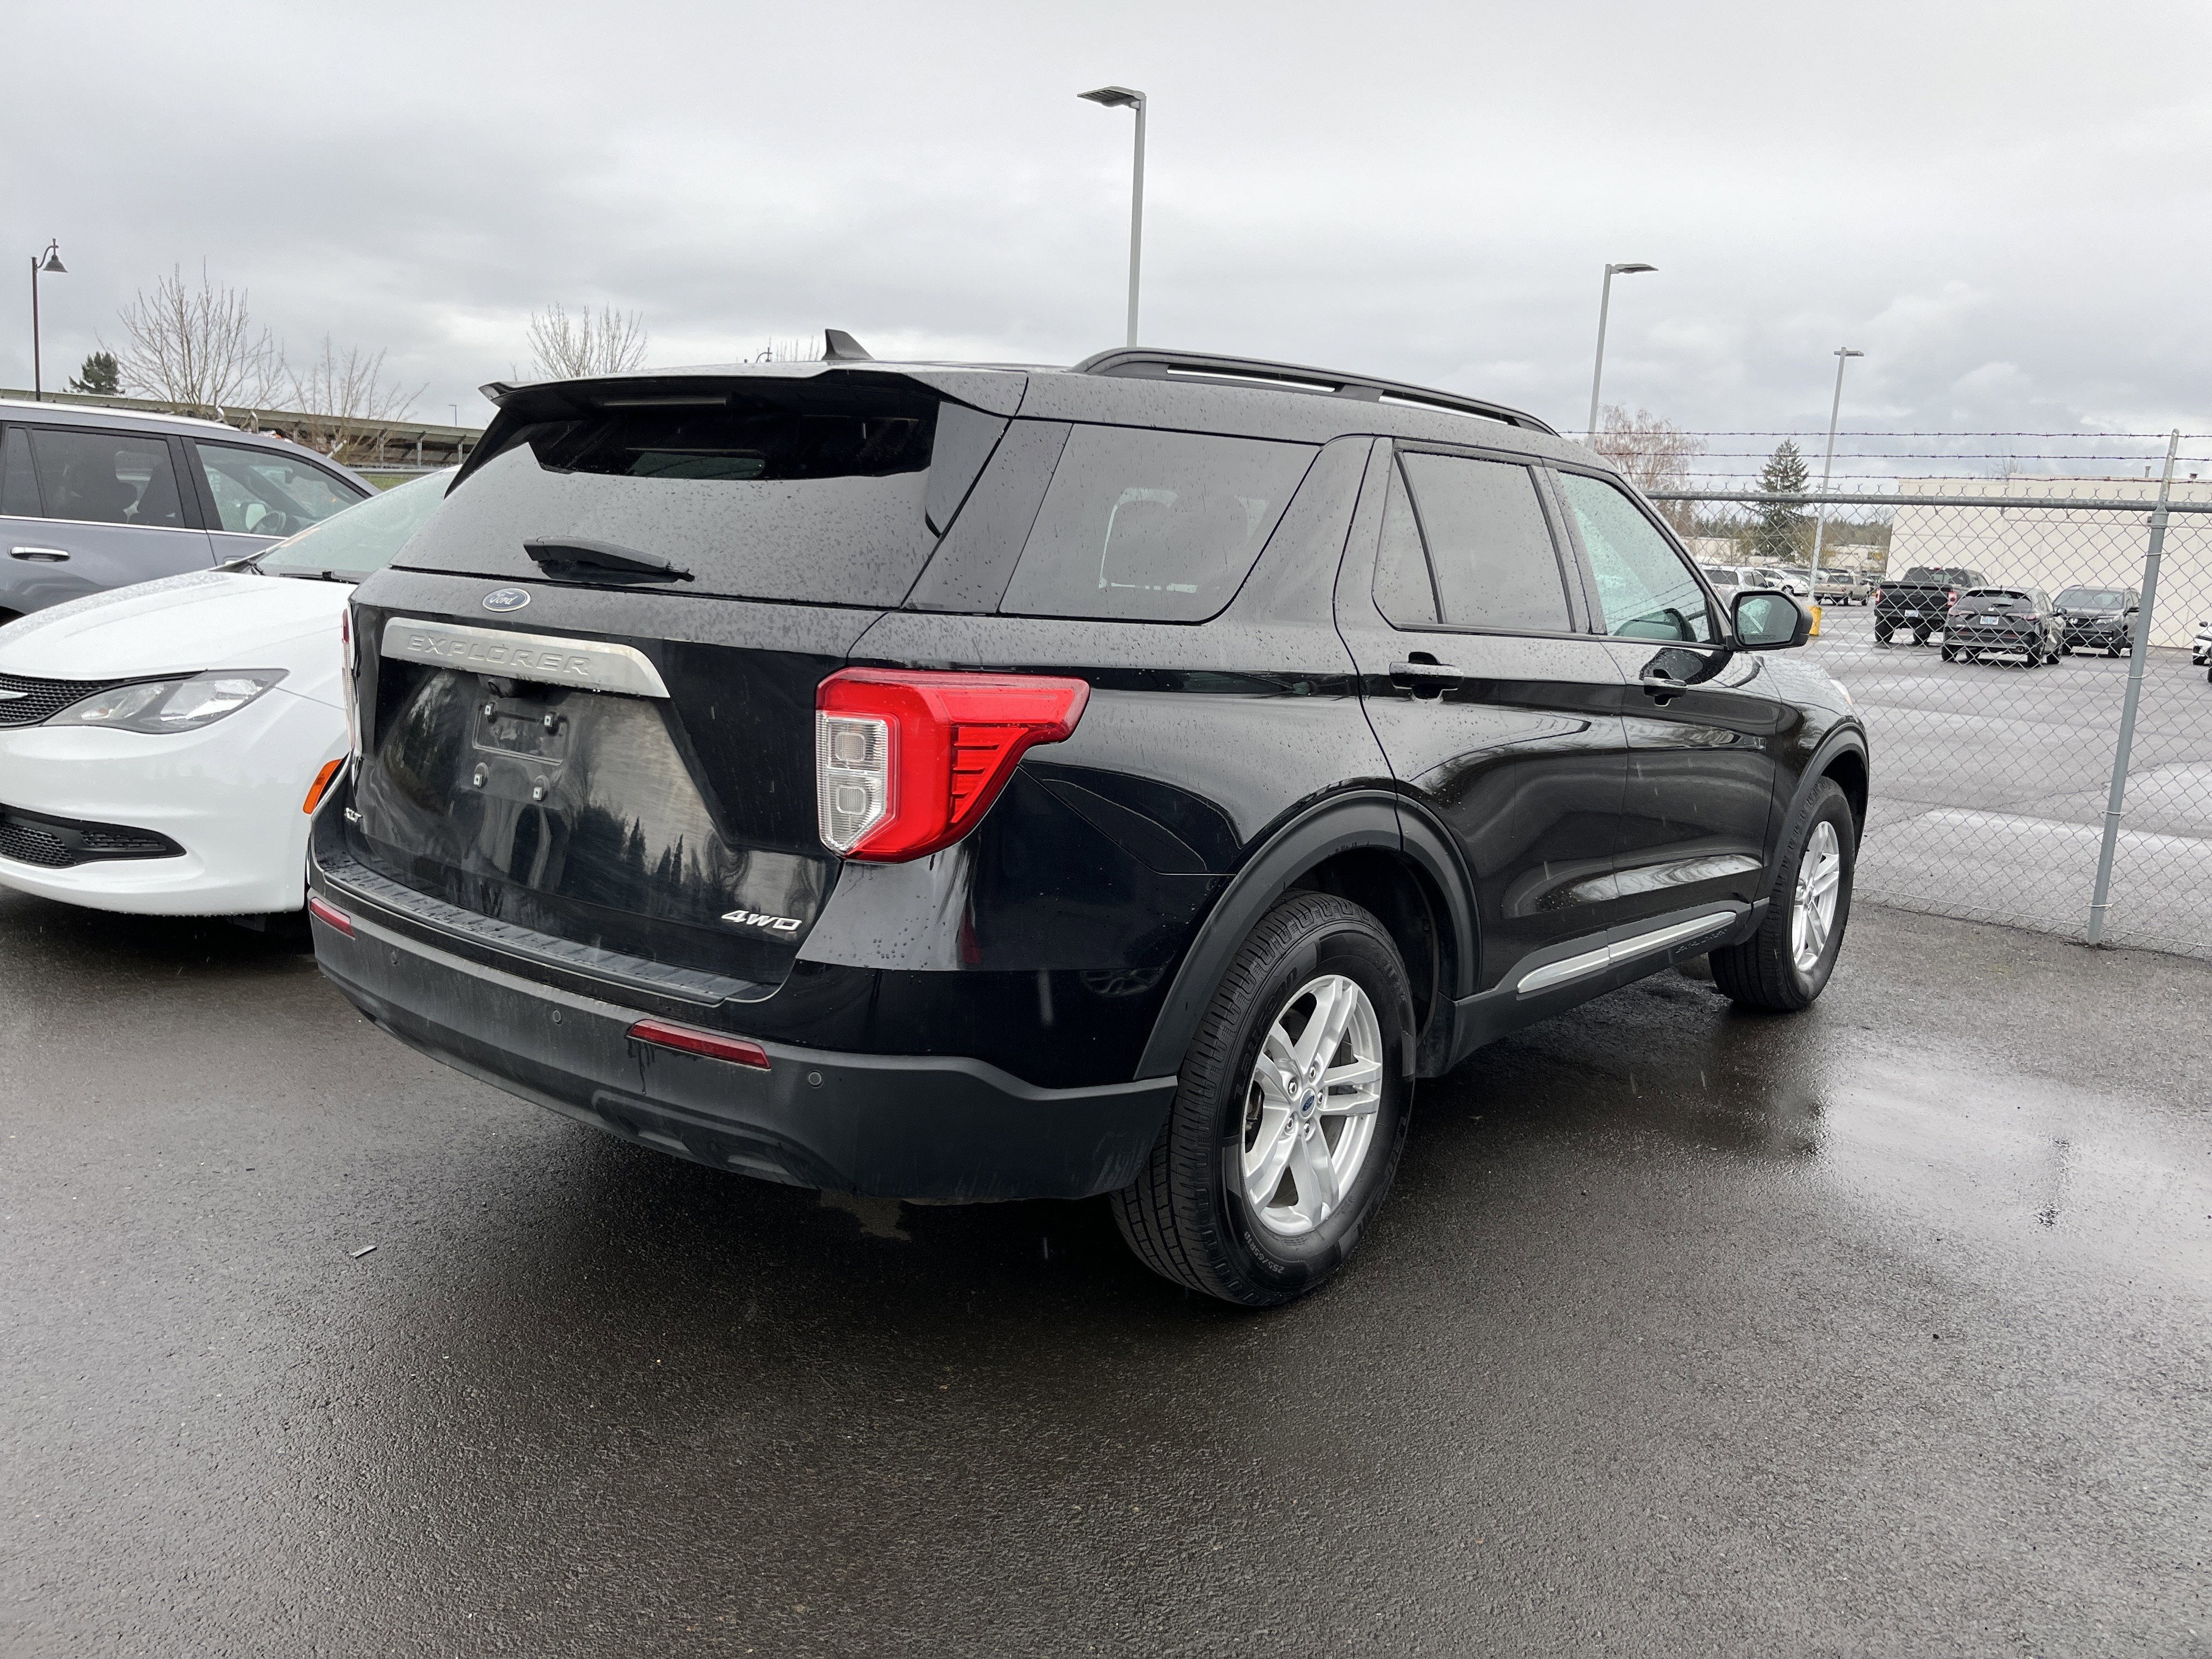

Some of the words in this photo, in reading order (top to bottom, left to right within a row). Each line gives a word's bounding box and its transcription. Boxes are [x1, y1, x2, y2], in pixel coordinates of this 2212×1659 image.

[489, 591, 518, 605] Ford
[407, 635, 591, 675] EXPLORER
[344, 807, 362, 822] XLT
[721, 910, 803, 930] 4WD
